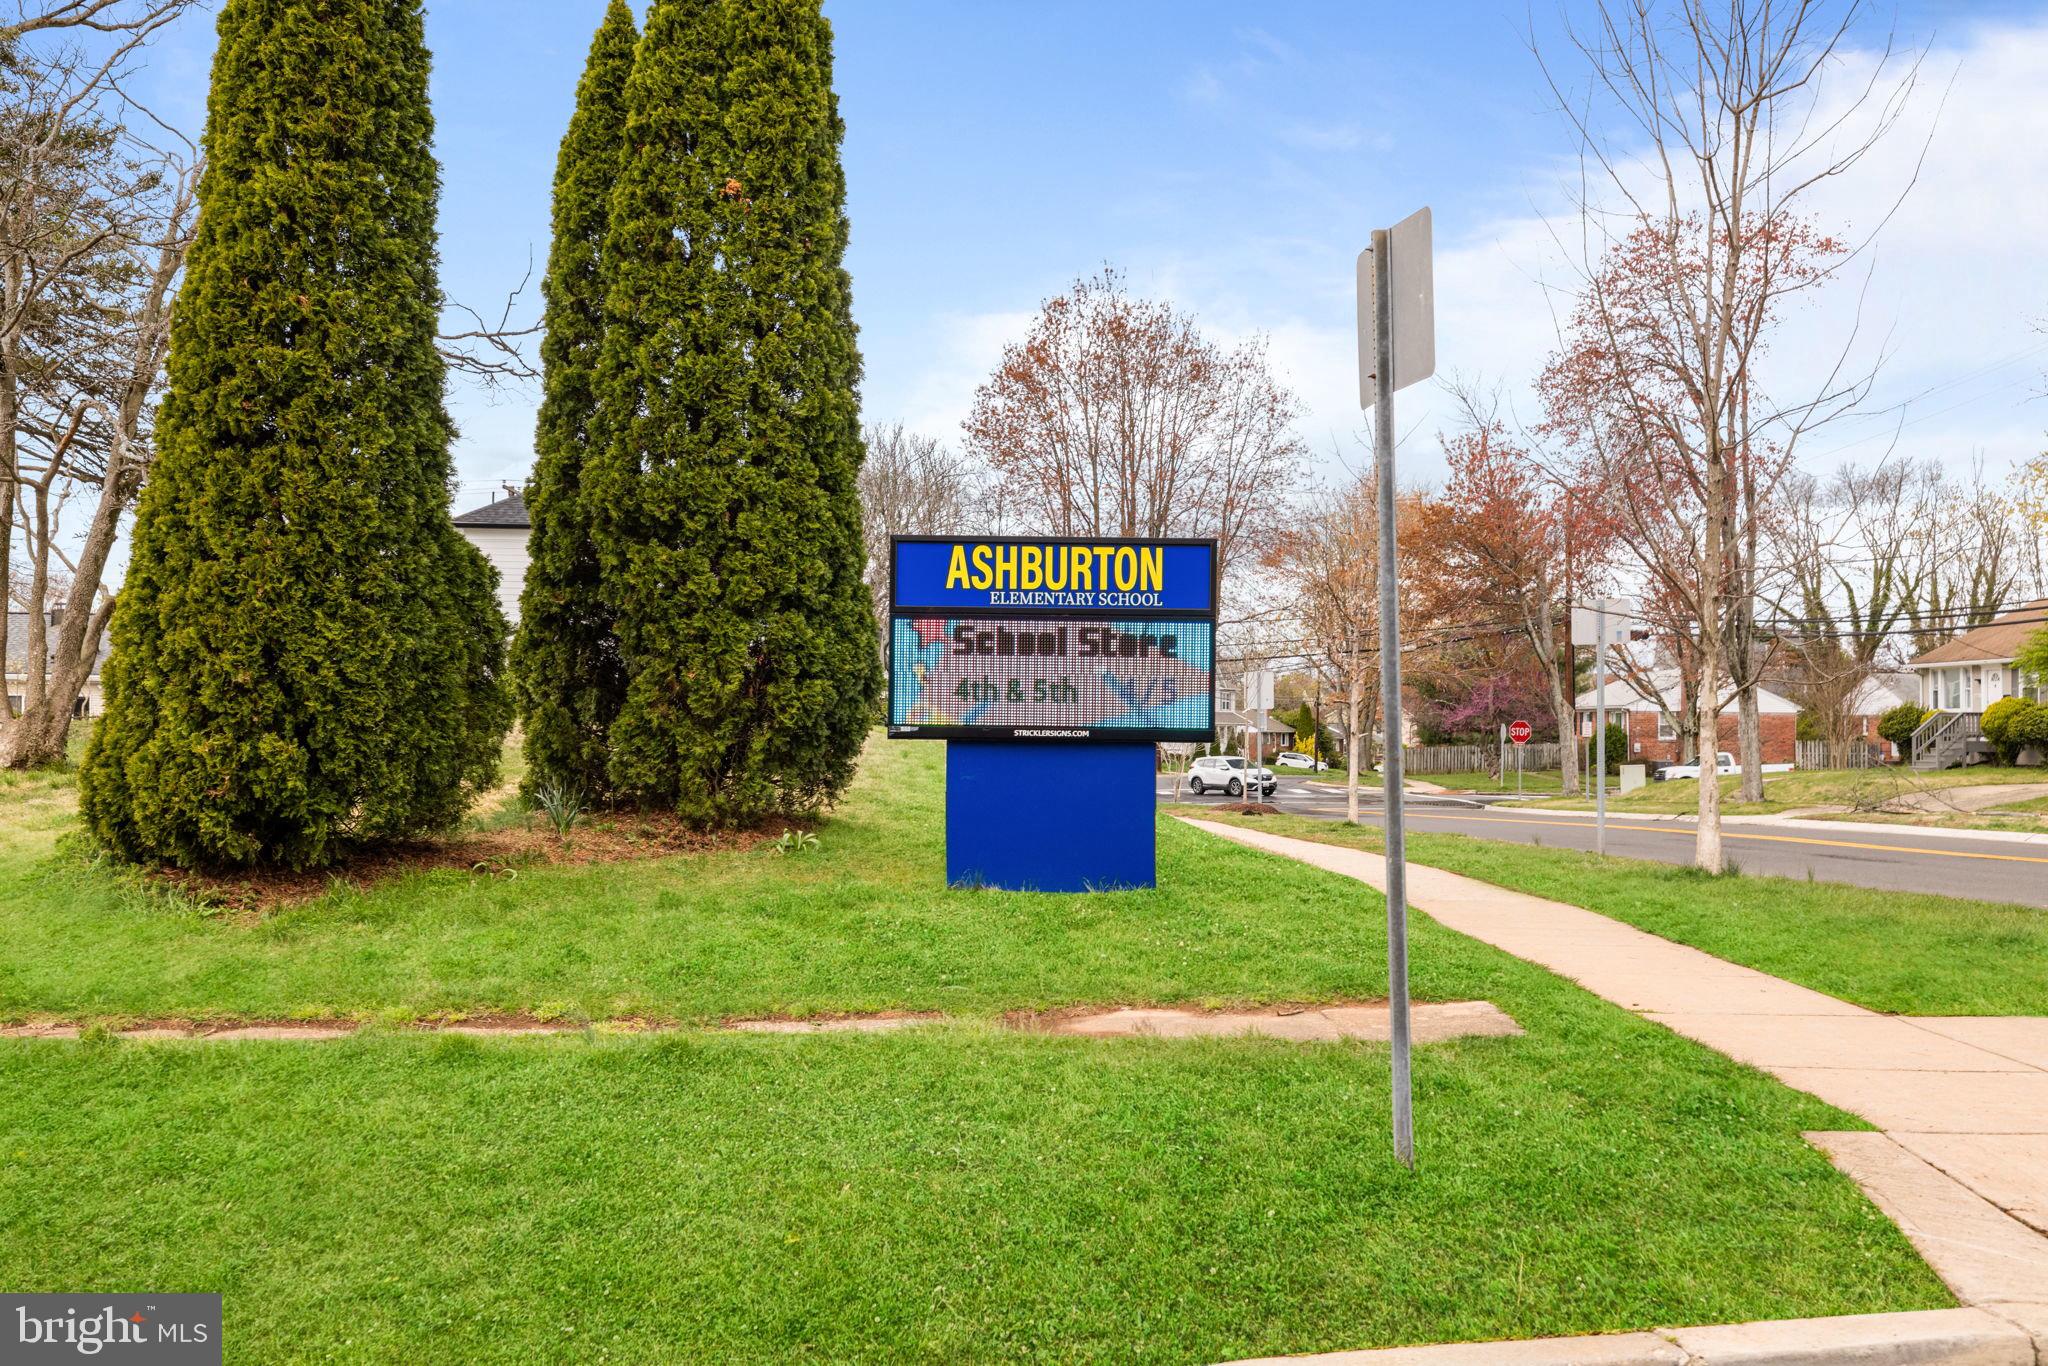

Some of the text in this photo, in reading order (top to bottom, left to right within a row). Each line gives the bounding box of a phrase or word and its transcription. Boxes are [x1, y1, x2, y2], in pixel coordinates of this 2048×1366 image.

[946, 545, 1163, 591] ASHBURTON
[989, 591, 1163, 607] ELEMENTARY SCHOOL
[953, 624, 1178, 658] School Store
[955, 676, 999, 702] 4th
[1007, 678, 1025, 704] &
[1033, 676, 1078, 704] 5th
[1013, 729, 1090, 738] STRICKLERSIGNS.COM
[1511, 727, 1530, 737] STOP
